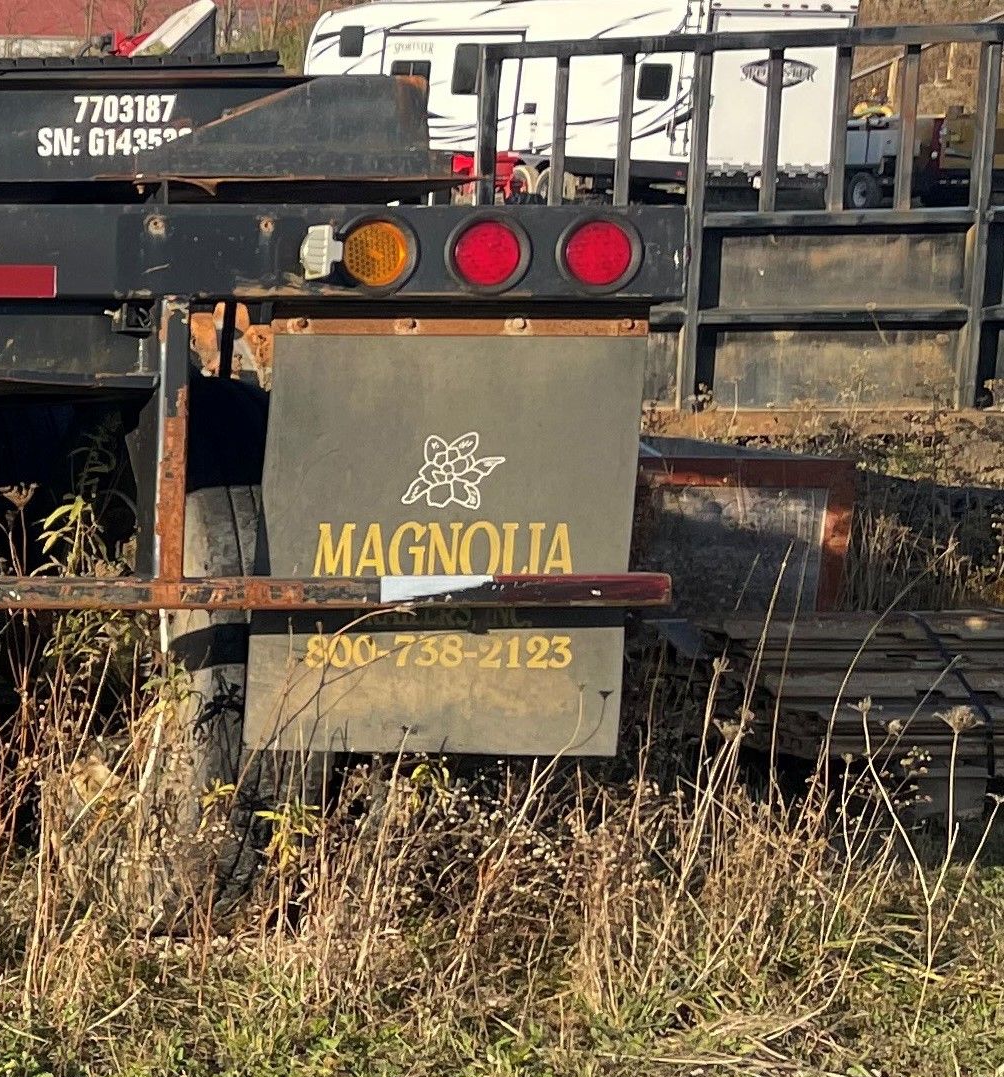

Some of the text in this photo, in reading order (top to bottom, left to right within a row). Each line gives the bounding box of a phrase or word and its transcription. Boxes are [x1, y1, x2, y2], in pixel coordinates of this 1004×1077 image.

[73, 94, 177, 123] 7703187
[37, 128, 80, 156] SN:
[310, 521, 573, 577] MAGNOLIA
[305, 634, 573, 669] 800-738-2123
